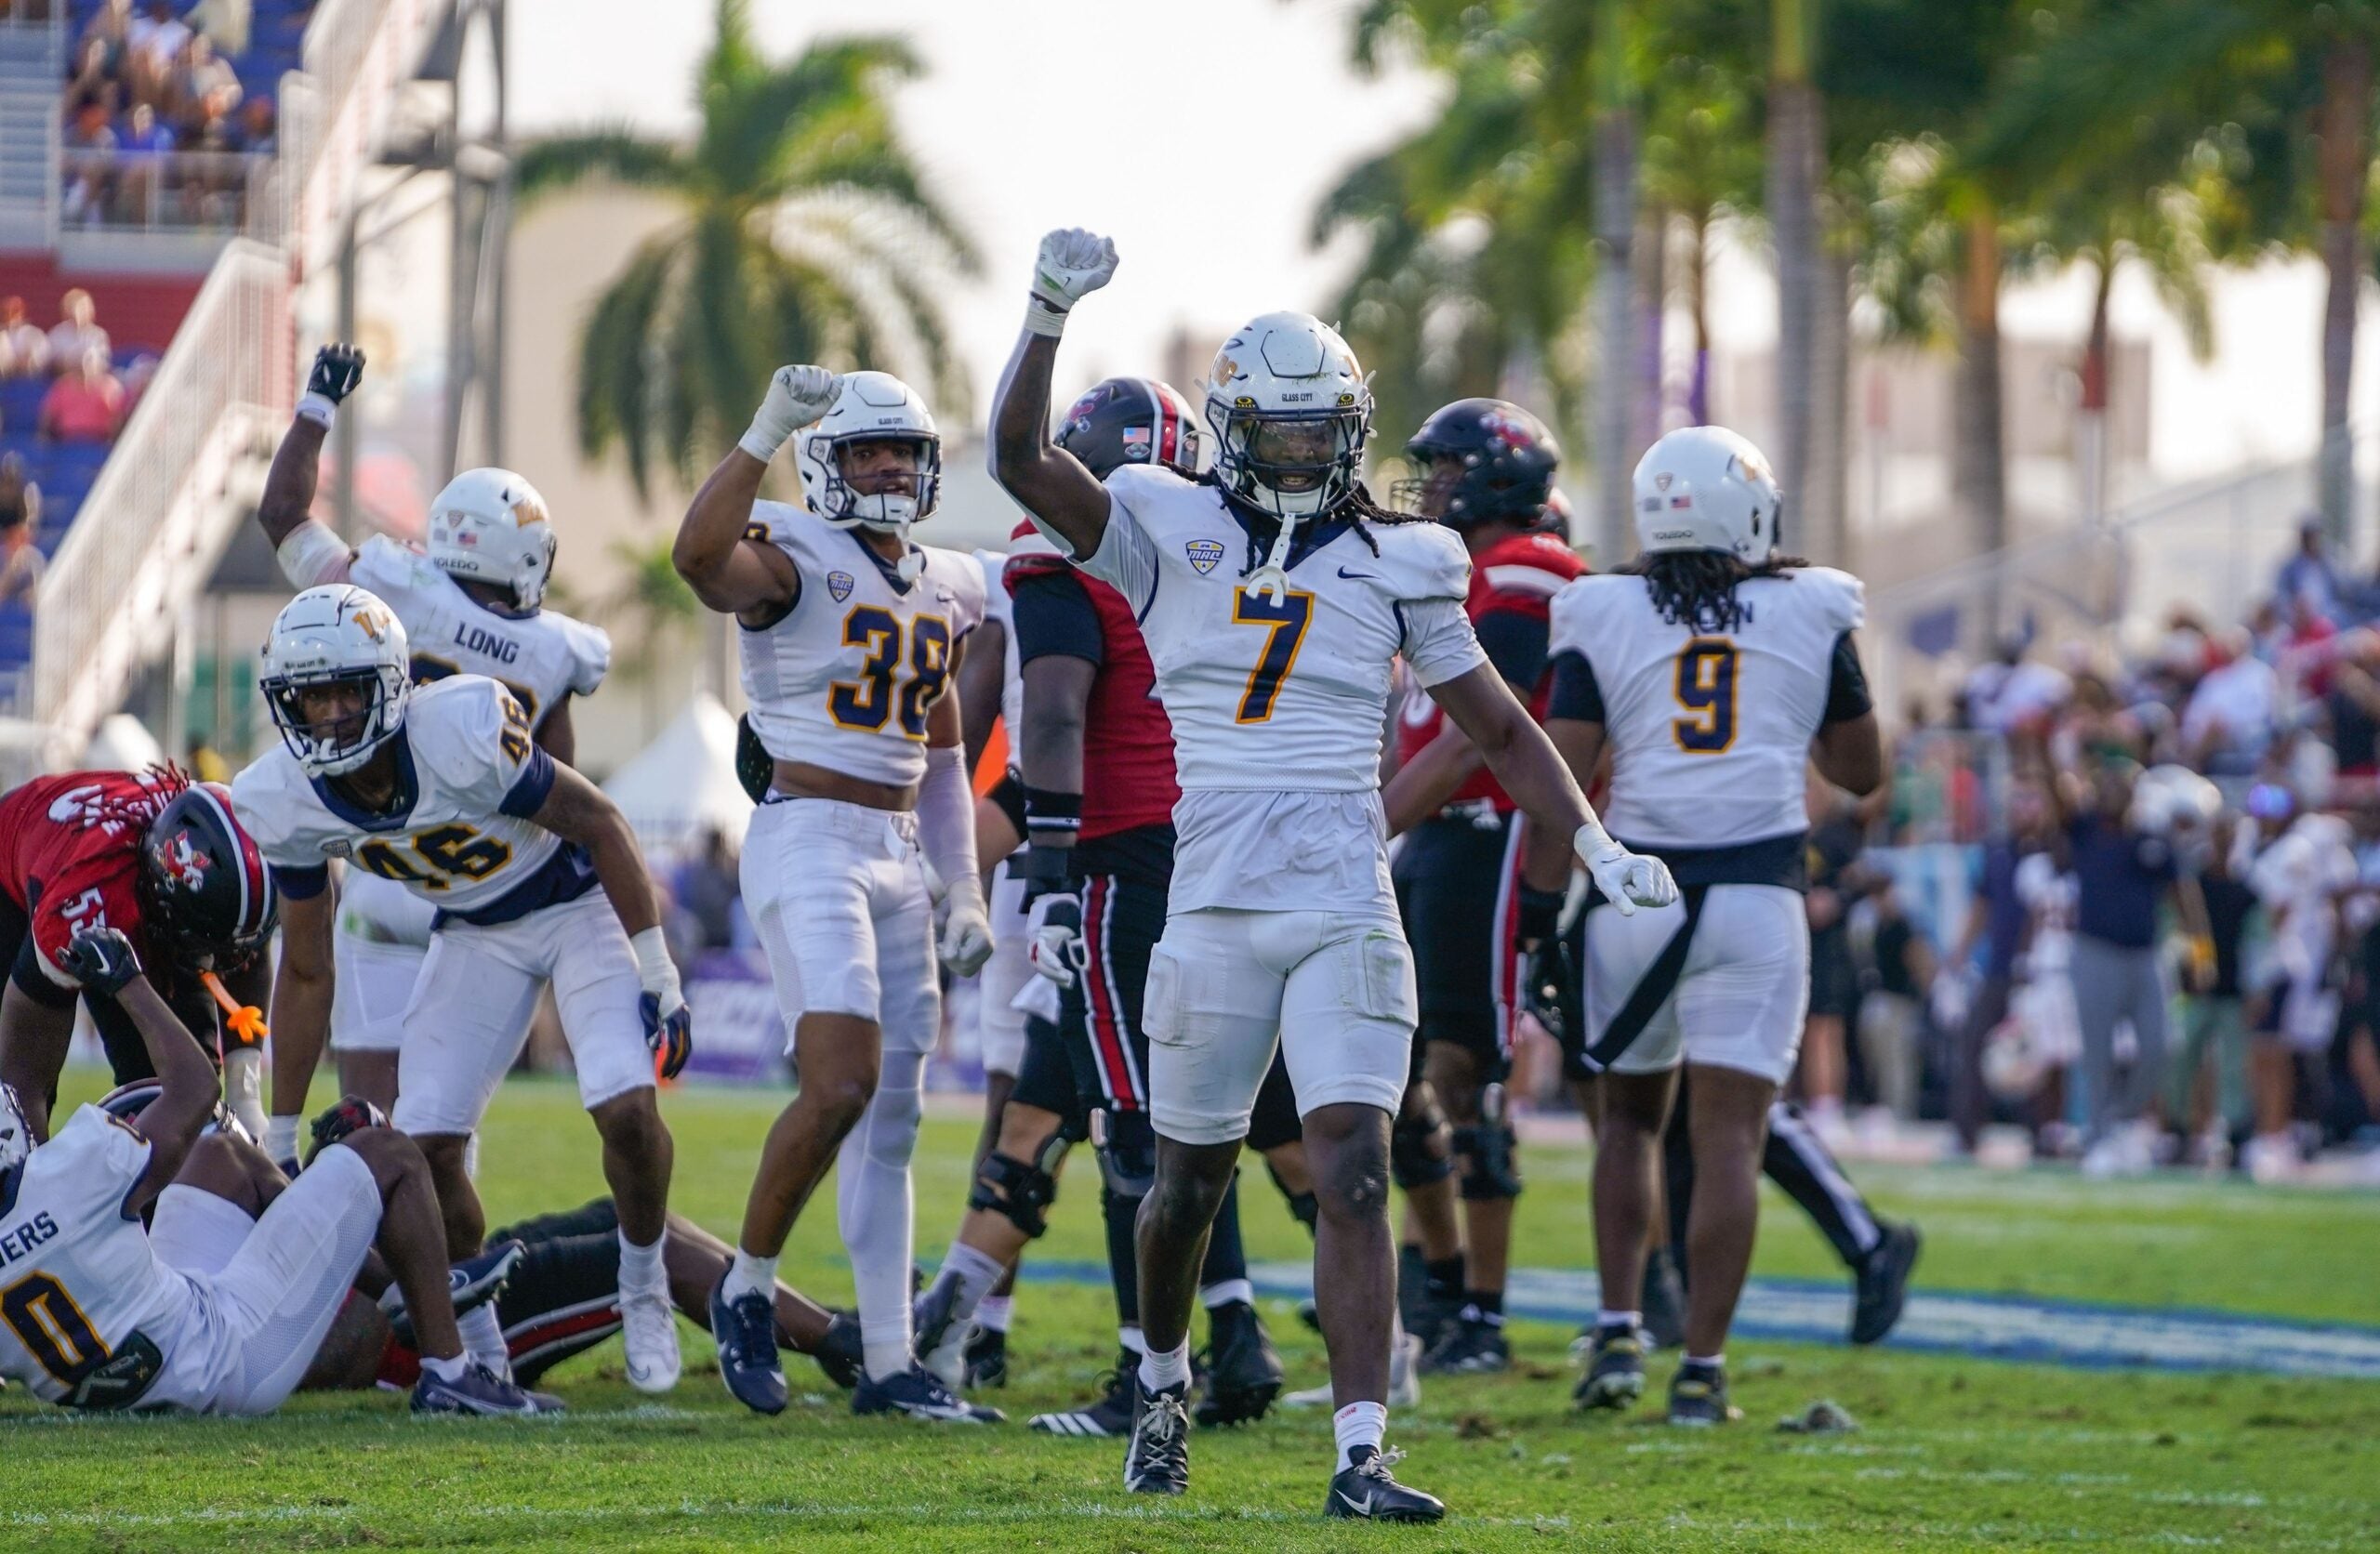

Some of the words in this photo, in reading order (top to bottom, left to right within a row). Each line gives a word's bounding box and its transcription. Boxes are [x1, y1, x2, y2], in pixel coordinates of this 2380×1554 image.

[1281, 392, 1300, 402] GLASS
[1300, 392, 1314, 402] CITY
[827, 578, 853, 592] MAC
[1187, 549, 1223, 561] MAC
[454, 620, 520, 665] LONG
[826, 602, 951, 743] 38
[1231, 585, 1316, 725] 7
[1672, 635, 1741, 755] 9
[499, 695, 532, 769] 46
[356, 821, 513, 892] 46
[0, 1210, 60, 1269] ERS
[0, 1270, 112, 1392] 0
